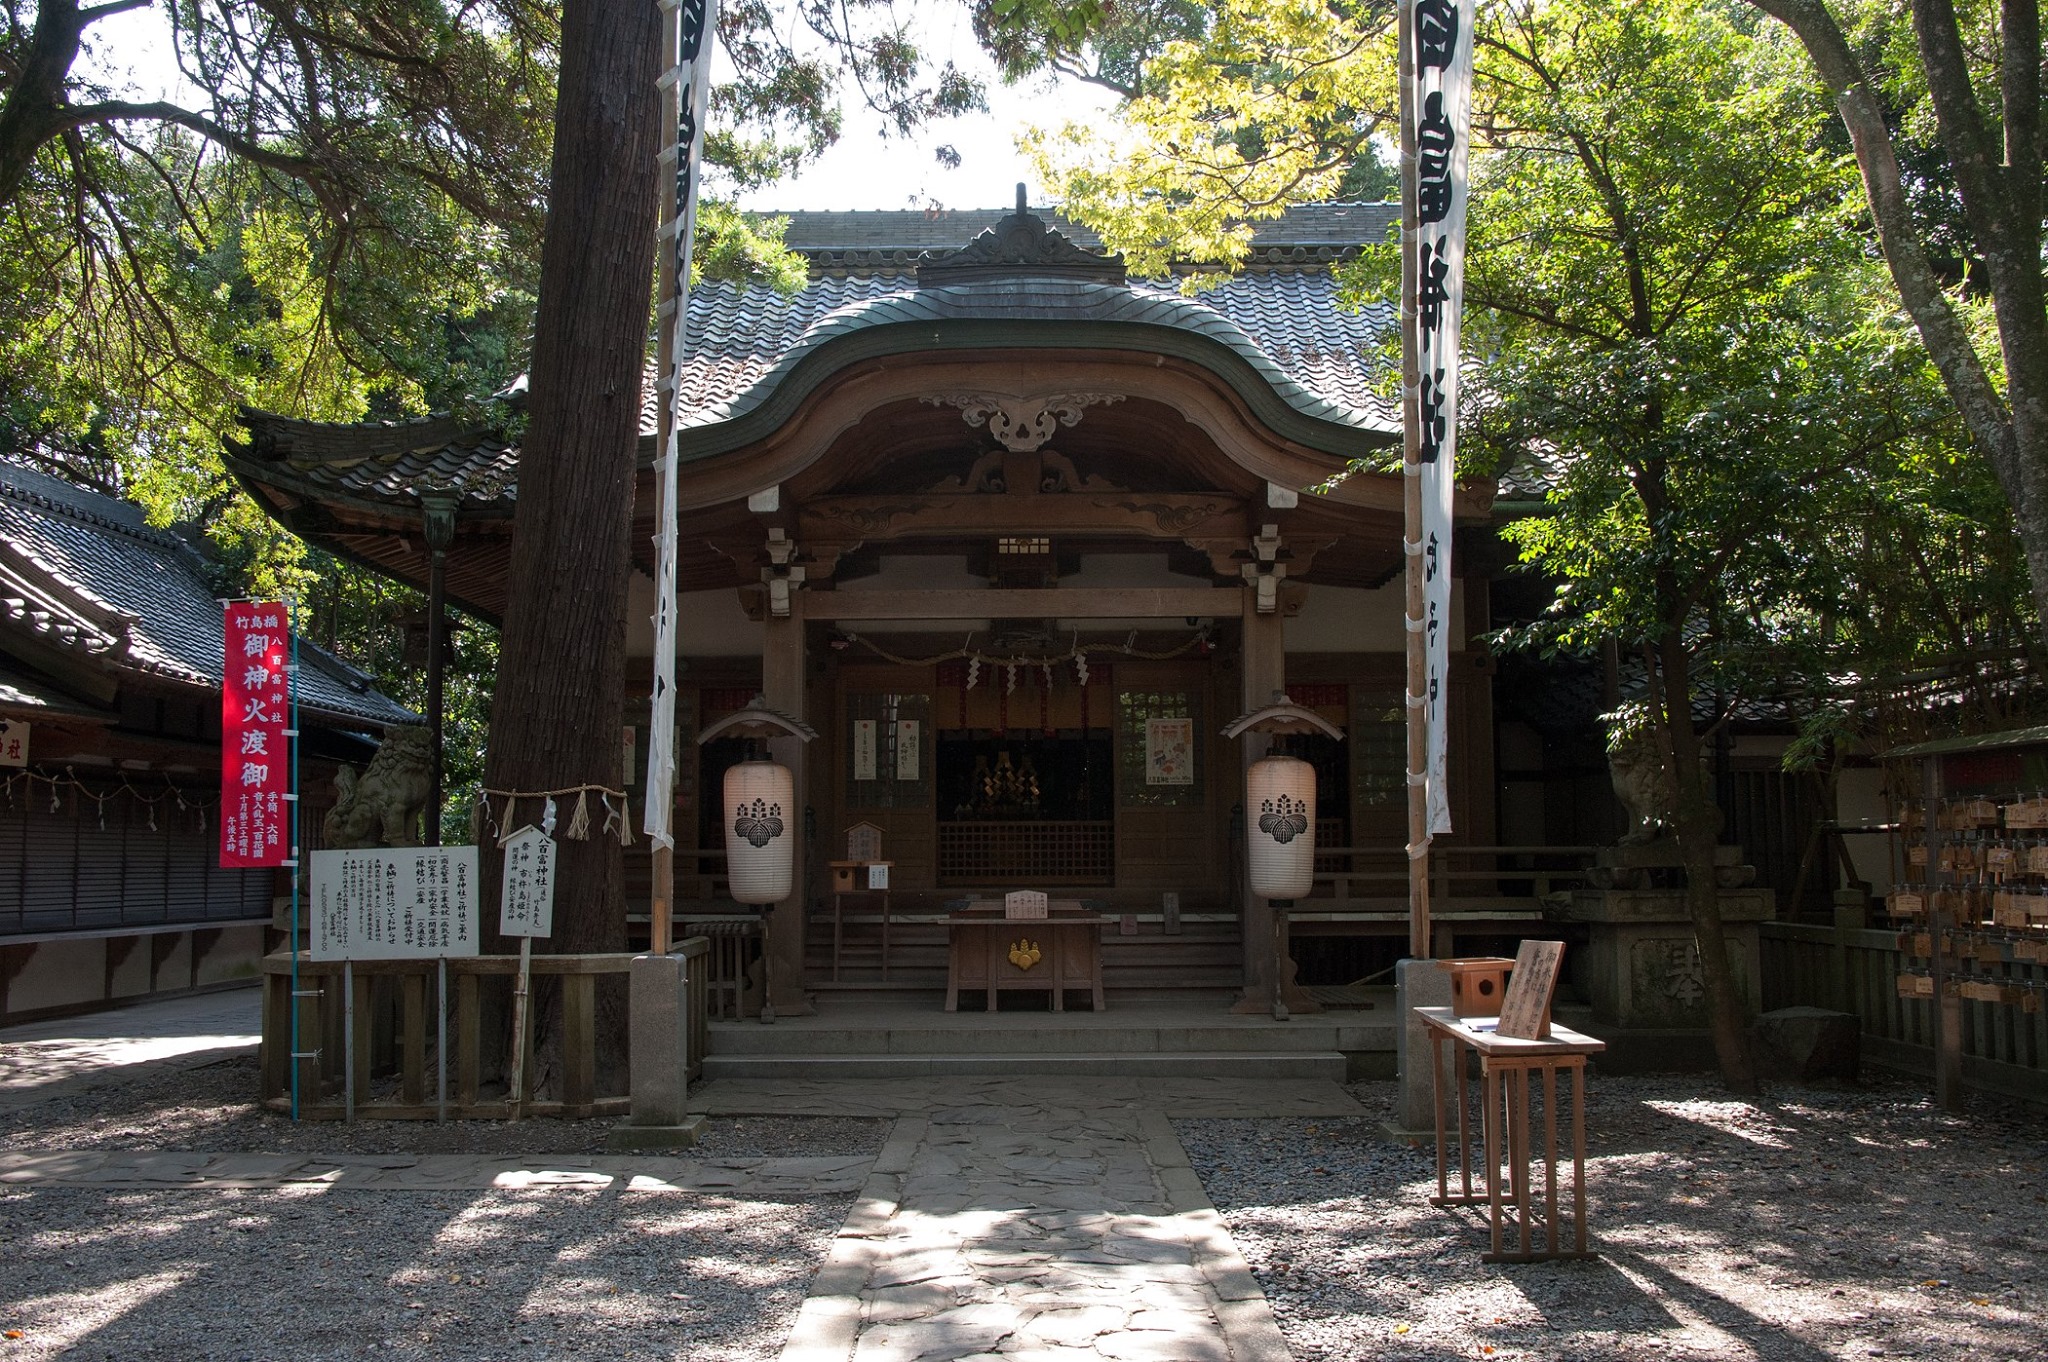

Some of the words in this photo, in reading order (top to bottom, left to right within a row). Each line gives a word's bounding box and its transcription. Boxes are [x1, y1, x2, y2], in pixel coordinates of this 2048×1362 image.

[236, 615, 278, 629] 竹島橋
[240, 634, 270, 788] 御神火渡御
[271, 636, 283, 723] 八百富神社
[239, 793, 249, 857] 十月第三土曜日
[521, 842, 531, 862] 祭神
[535, 838, 551, 886] 八百富神社
[457, 862, 467, 941] 八百富神社ご祈祷ご案内
